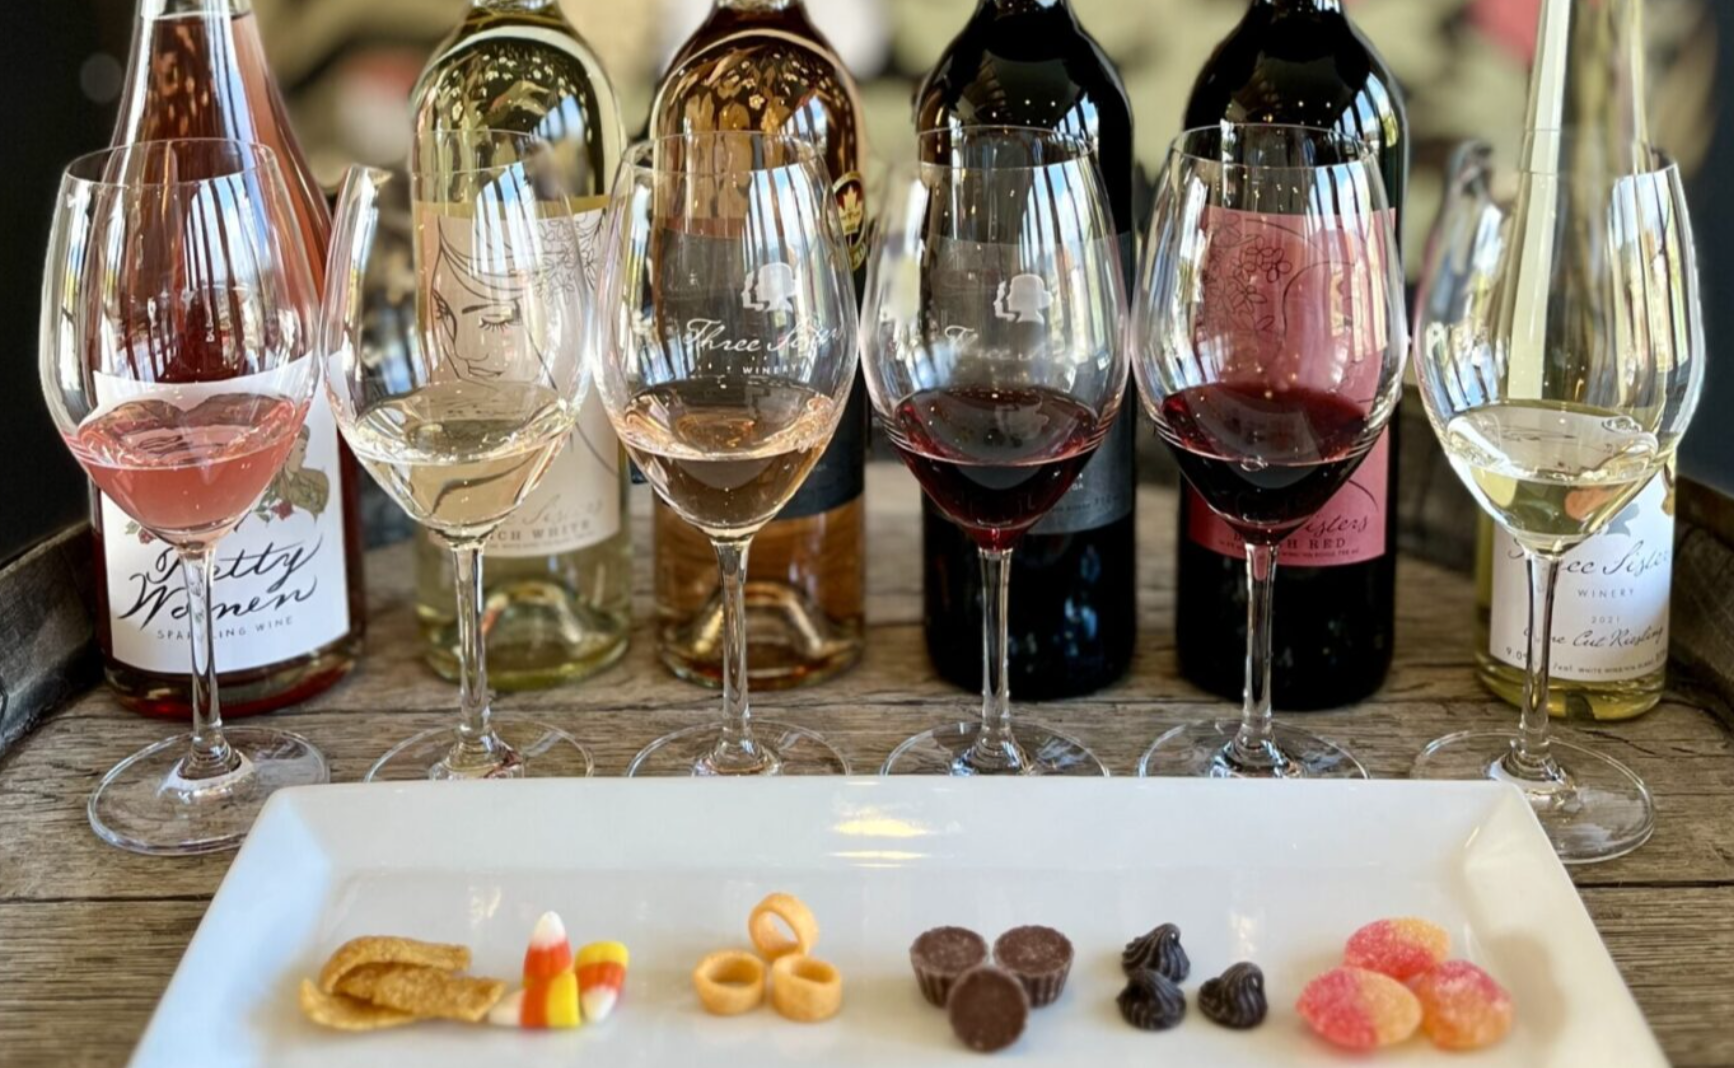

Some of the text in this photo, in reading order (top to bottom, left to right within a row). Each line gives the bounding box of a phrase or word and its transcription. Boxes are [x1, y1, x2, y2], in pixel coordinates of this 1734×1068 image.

[683, 318, 762, 351] Three
[742, 364, 798, 376] WINERY
[533, 520, 589, 539] WHITE
[1305, 514, 1367, 537] isters
[1309, 538, 1345, 549] RED
[146, 533, 323, 593] Petty
[1577, 587, 1634, 600] WINERY
[157, 616, 294, 641] SPAING WINE
[1591, 616, 1620, 624] 2021
[1573, 630, 1606, 647] Cut
[1609, 625, 1664, 648] Riesling
